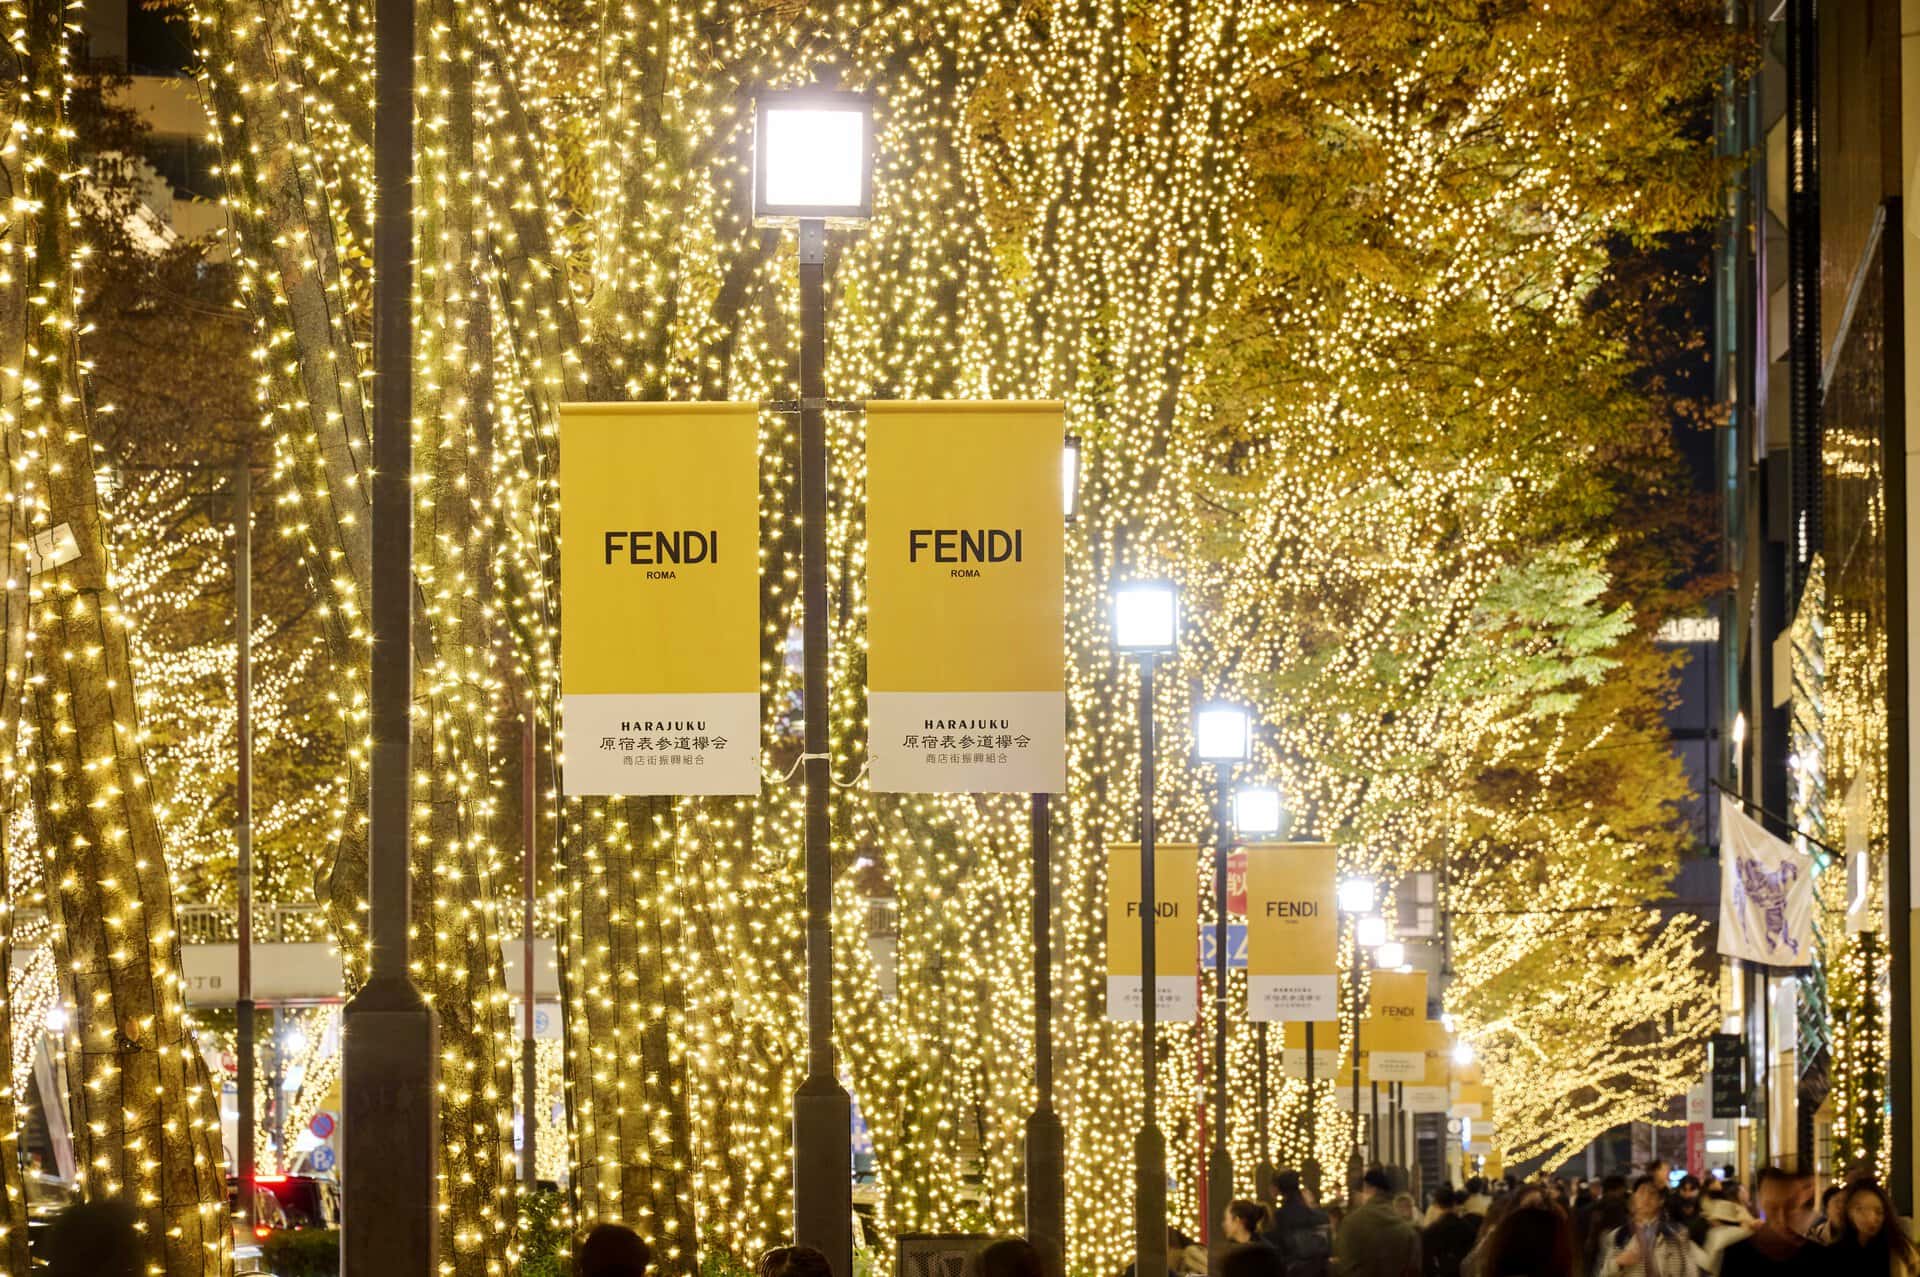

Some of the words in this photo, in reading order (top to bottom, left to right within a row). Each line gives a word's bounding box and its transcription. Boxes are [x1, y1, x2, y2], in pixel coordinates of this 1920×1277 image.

[605, 531, 717, 565] FENDI
[909, 529, 1022, 563] FENDI
[646, 571, 677, 580] ROMA
[950, 569, 981, 578] ROMA
[621, 721, 706, 731] HARAJUKU
[925, 719, 1009, 730] HARAJUKU
[1127, 901, 1178, 918] FNDI
[1266, 901, 1318, 917] FENDI
[1381, 1005, 1415, 1017] FENDI
